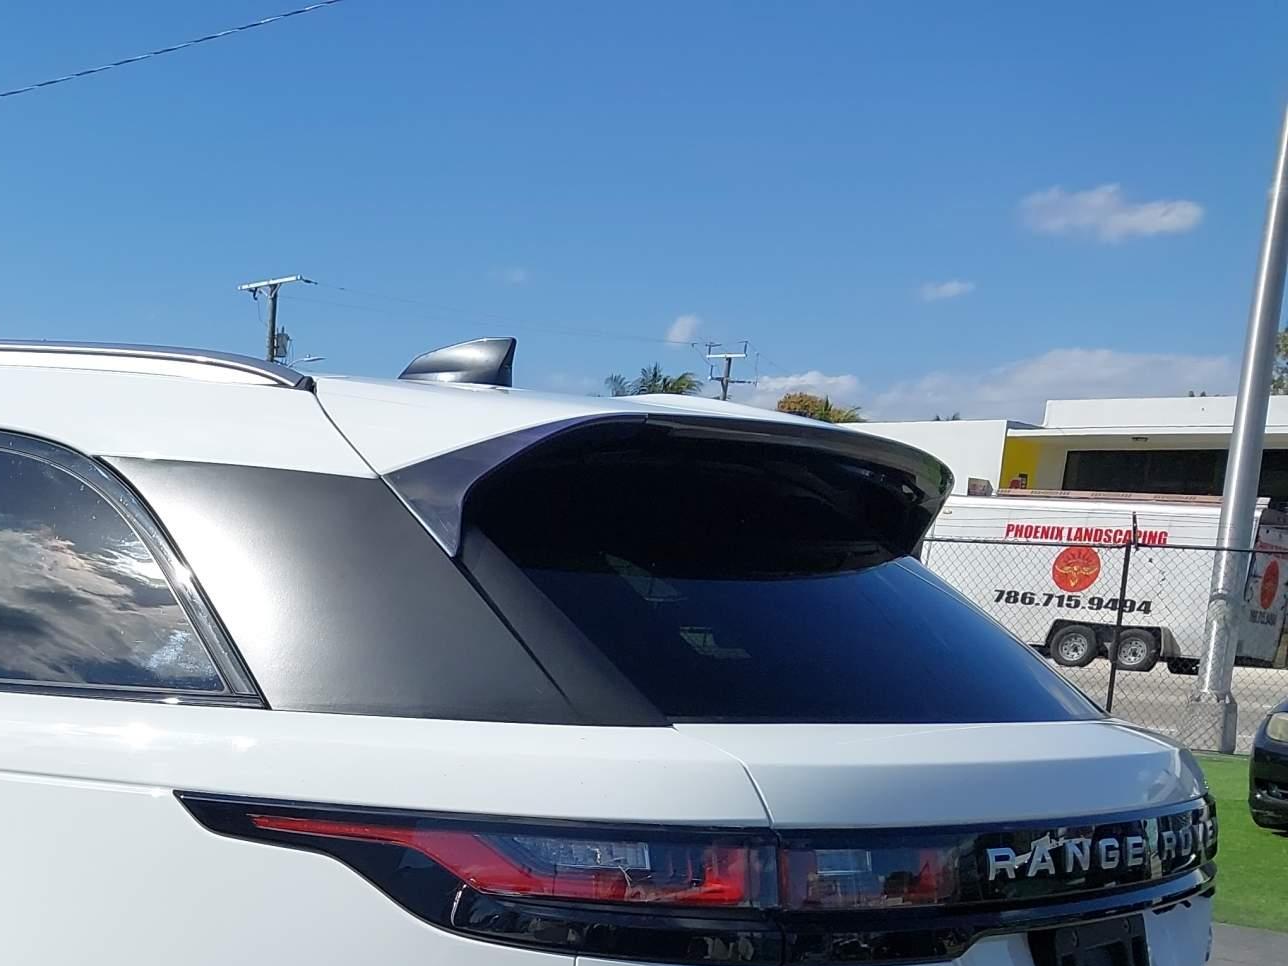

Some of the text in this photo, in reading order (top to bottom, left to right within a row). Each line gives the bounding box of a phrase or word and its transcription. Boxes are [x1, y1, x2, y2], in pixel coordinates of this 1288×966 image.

[1004, 523, 1169, 545] PHOENIX LANDSCAPING
[993, 588, 1153, 615] 786.715.9494
[986, 818, 1217, 881] RANGE ROVE
